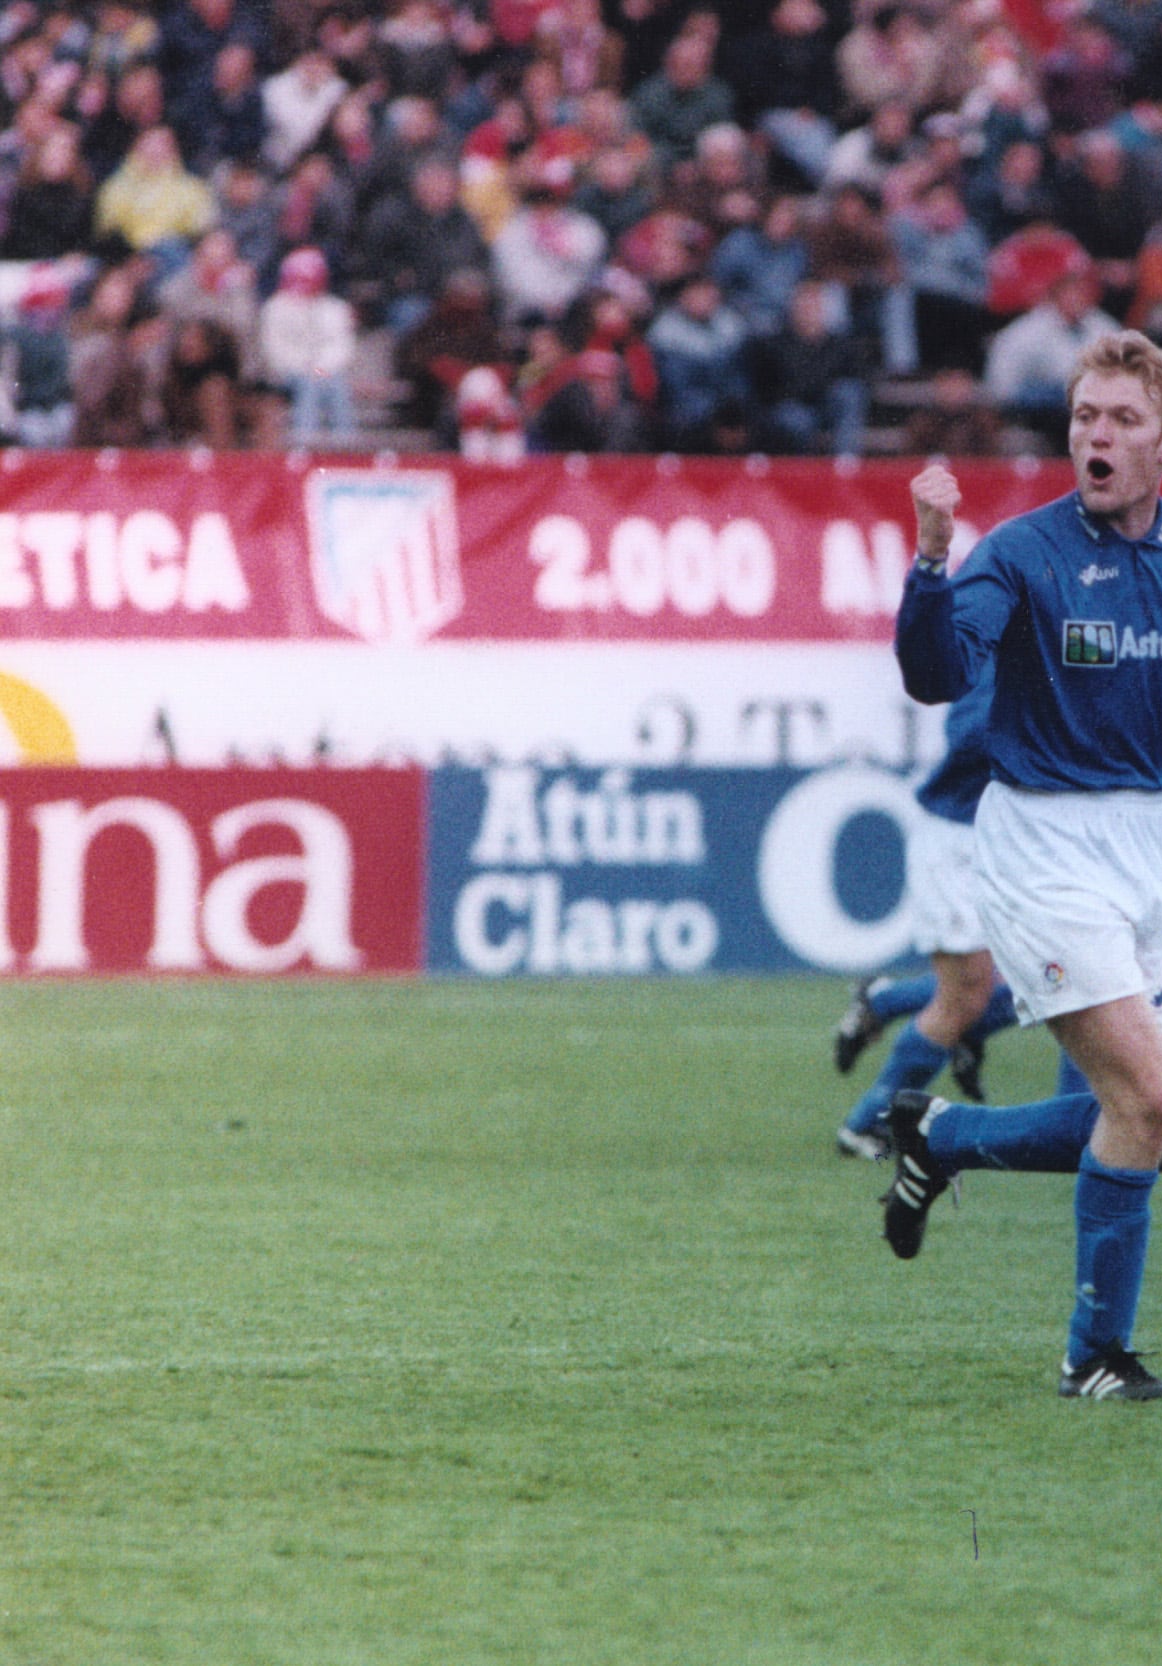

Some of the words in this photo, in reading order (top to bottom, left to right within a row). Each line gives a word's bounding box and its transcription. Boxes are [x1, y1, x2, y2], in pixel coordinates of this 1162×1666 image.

[529, 514, 776, 617] 2.000
[0, 795, 364, 973] na
[454, 870, 719, 974] Claro
